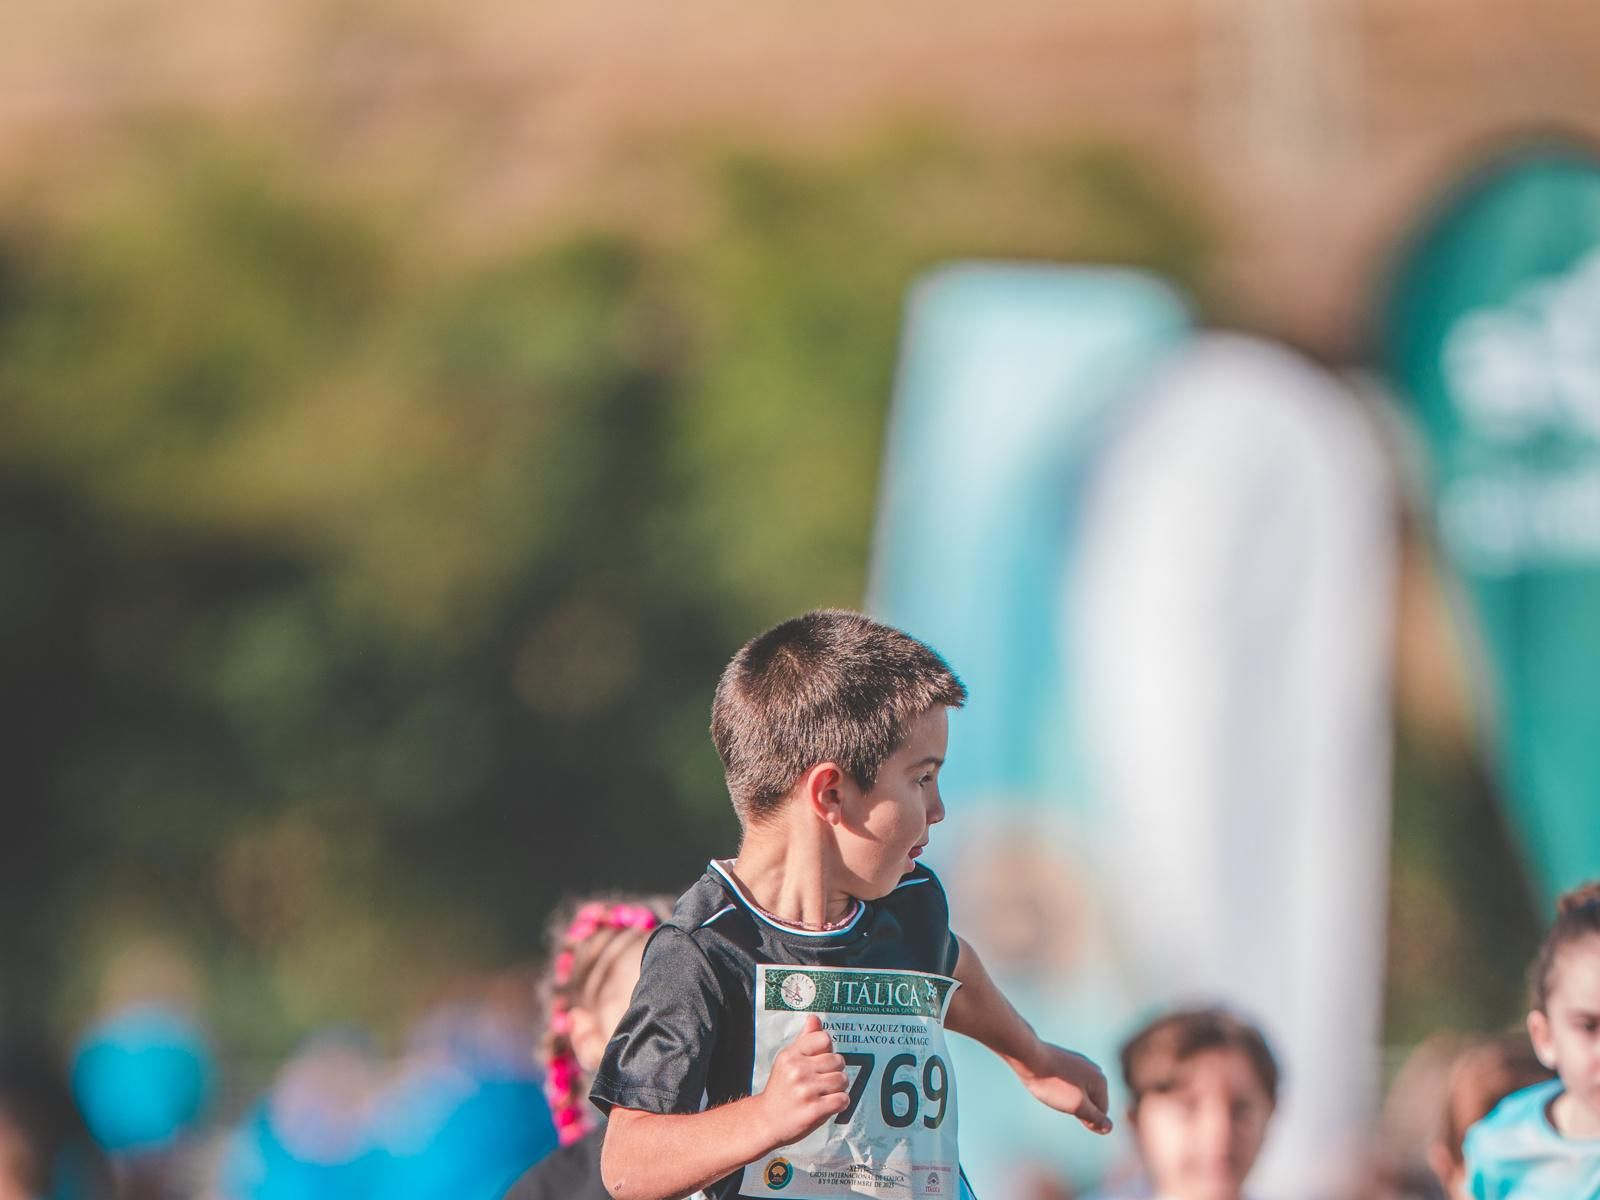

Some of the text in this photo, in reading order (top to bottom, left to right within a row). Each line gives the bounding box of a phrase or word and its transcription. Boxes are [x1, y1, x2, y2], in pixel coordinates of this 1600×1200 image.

[832, 976, 921, 1008] ITÁLICA
[823, 1022, 856, 1031] DANIEL
[858, 1023, 898, 1034] VAZQUEZ
